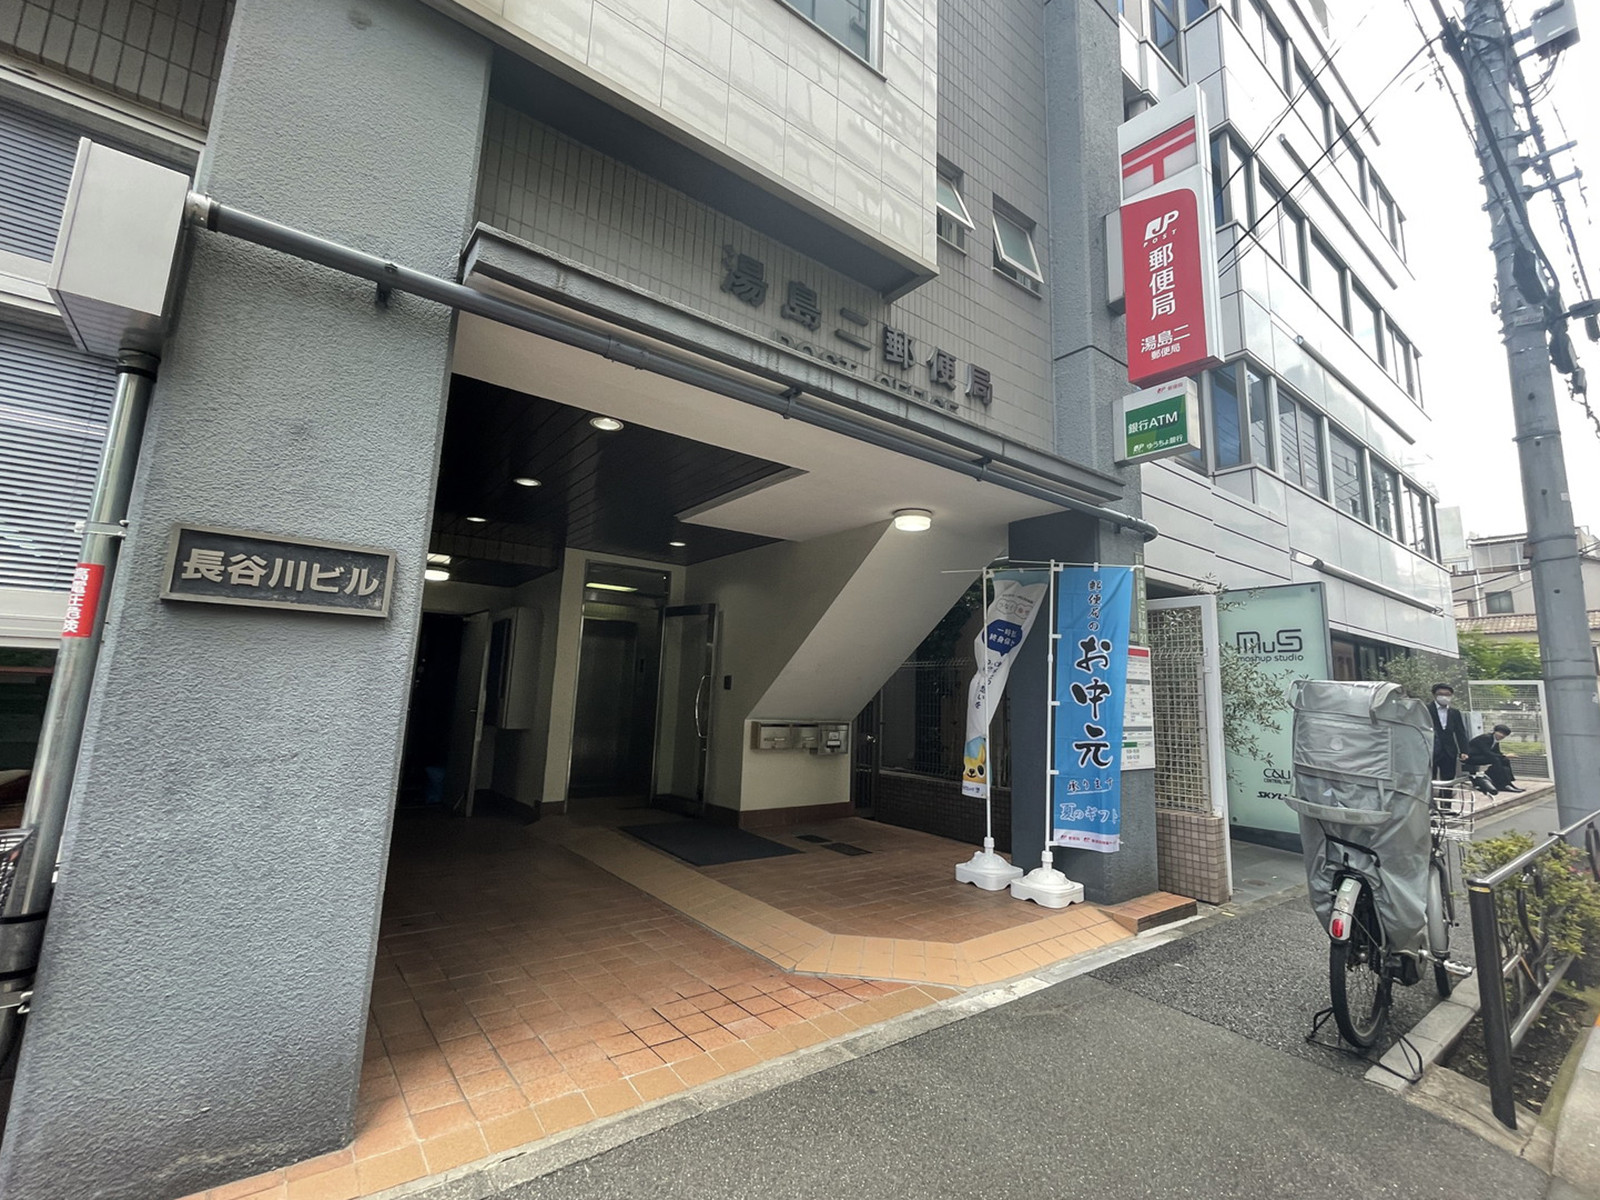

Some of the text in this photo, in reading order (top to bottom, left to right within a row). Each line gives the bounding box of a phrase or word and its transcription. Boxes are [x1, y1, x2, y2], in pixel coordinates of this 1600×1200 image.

[1143, 228, 1178, 248] POST
[1148, 242, 1176, 321] 郵便局
[1140, 323, 1191, 353] 湯島二
[1127, 411, 1178, 435] 銀行ATM
[181, 548, 380, 597] 長谷川ビル
[1274, 653, 1305, 662] studio
[1070, 635, 1114, 769] お中元
[1067, 777, 1114, 792] 承ります
[1257, 791, 1287, 801] SKYL
[1060, 802, 1120, 825] 夏のギフト
